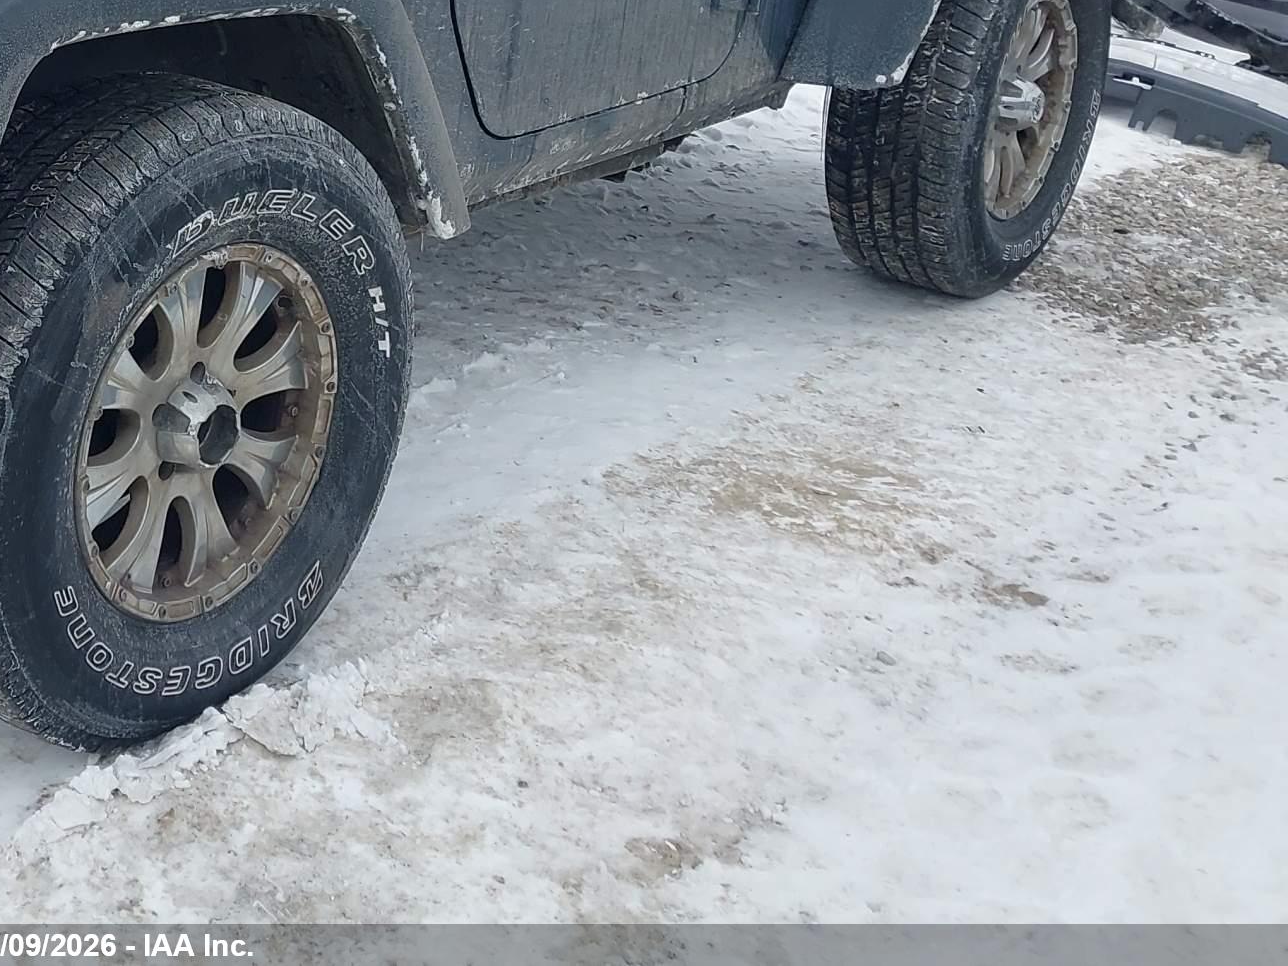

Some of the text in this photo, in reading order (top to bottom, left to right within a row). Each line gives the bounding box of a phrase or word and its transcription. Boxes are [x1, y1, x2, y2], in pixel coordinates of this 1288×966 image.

[171, 188, 392, 359] DUELER H/T
[53, 559, 325, 697] BRIDGESTONE
